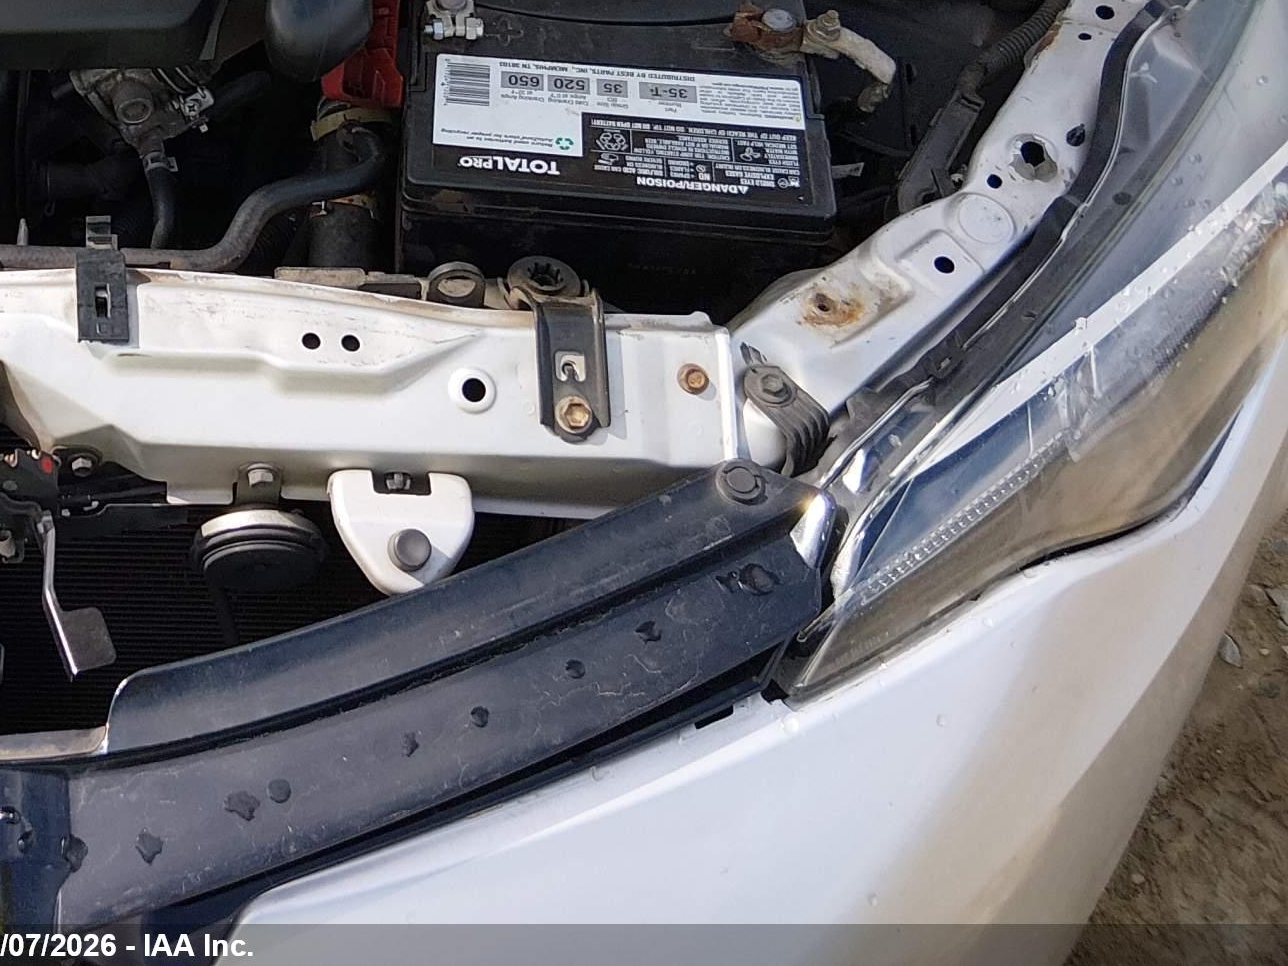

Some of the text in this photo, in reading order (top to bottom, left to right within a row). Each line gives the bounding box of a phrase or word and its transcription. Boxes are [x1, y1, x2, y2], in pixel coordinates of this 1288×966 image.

[509, 74, 539, 87] 650
[648, 73, 695, 82] DISTRIBUTED
[554, 78, 585, 91] 520
[604, 82, 622, 94] 35
[637, 177, 738, 194] DANGER/POISON
